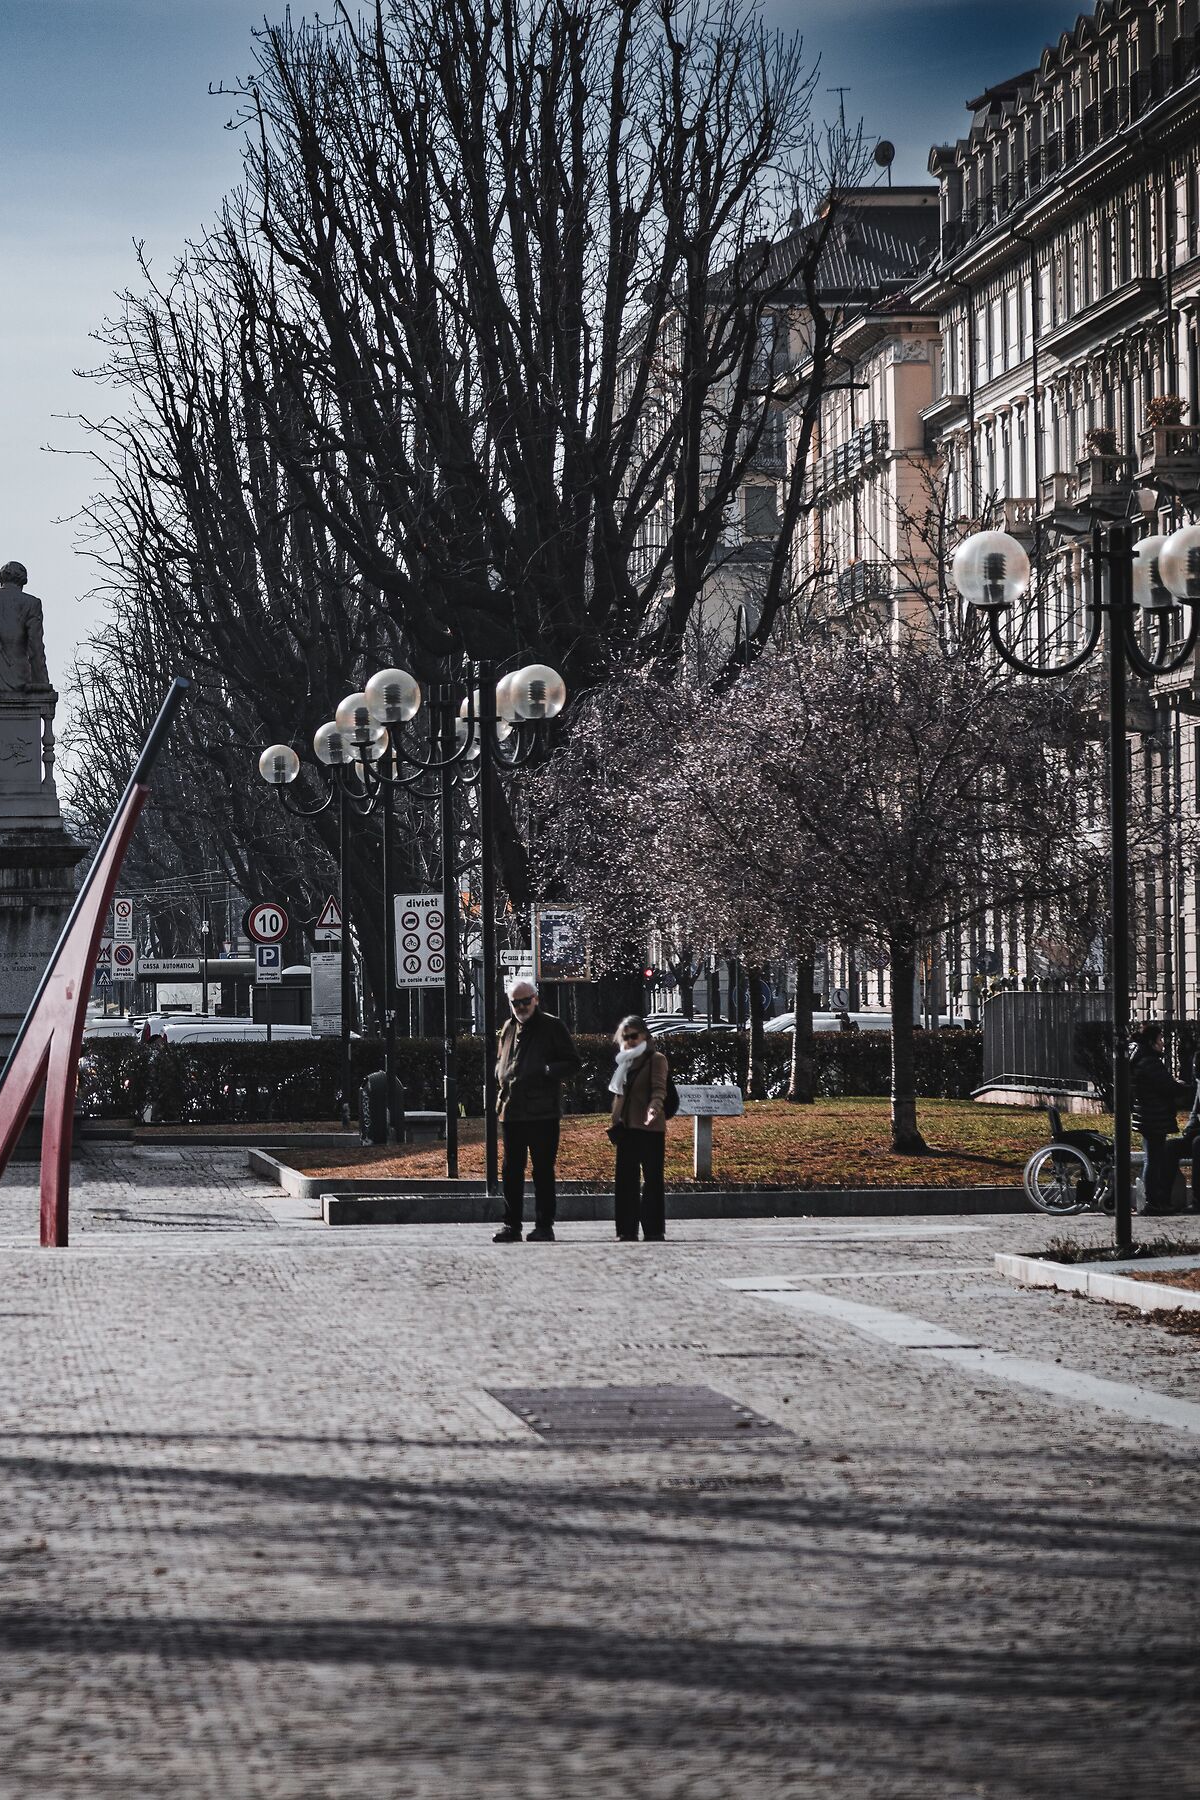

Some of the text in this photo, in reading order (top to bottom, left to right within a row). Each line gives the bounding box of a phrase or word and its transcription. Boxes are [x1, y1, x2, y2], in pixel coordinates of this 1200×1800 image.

[406, 898, 438, 908] divieti
[259, 914, 279, 933] 10
[263, 949, 275, 965] P
[432, 959, 441, 968] 10
